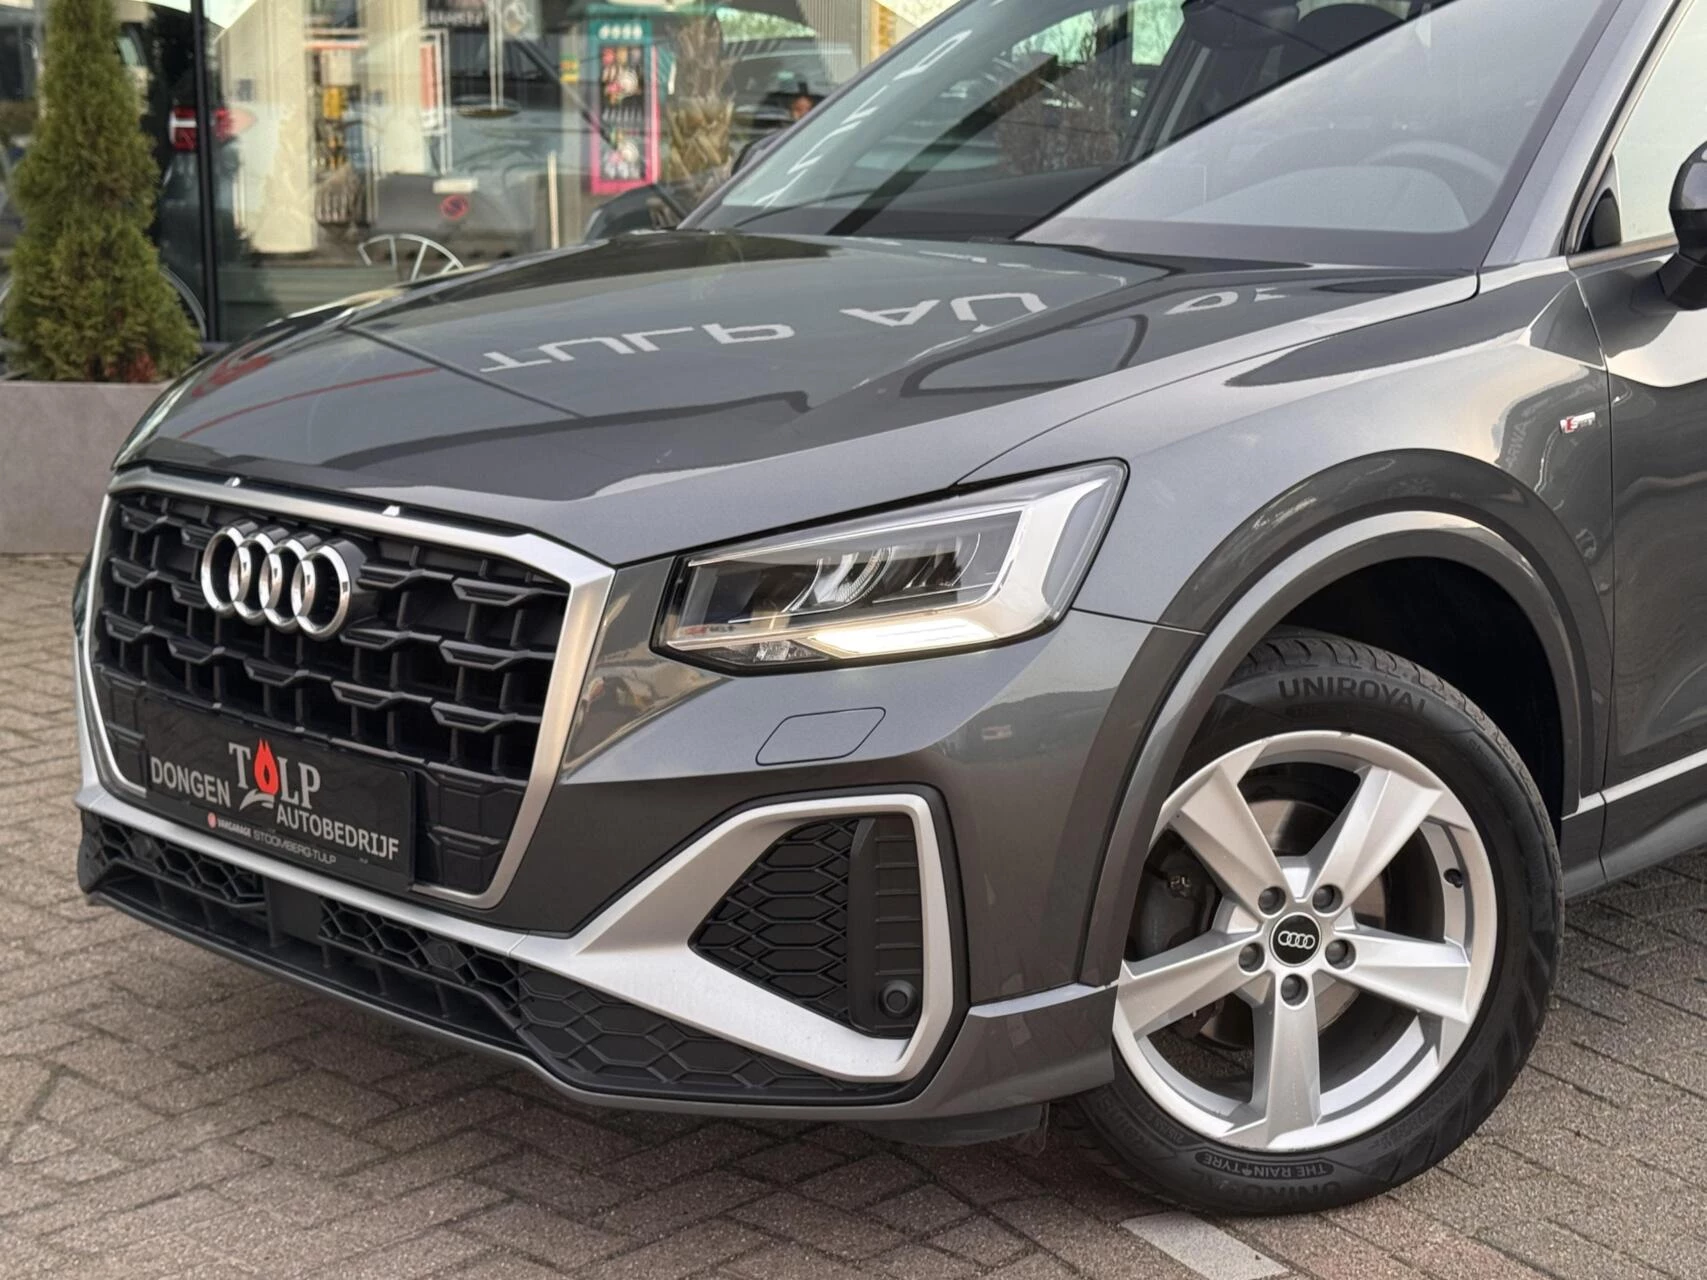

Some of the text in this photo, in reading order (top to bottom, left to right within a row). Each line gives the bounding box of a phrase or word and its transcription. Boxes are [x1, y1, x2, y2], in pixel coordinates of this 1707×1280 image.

[1278, 676, 1426, 714] UNIROYAL
[150, 756, 231, 808] DONGEN
[276, 803, 400, 861] AUTOBEDRIJF
[1204, 1153, 1326, 1178] THE RAIN TYRE
